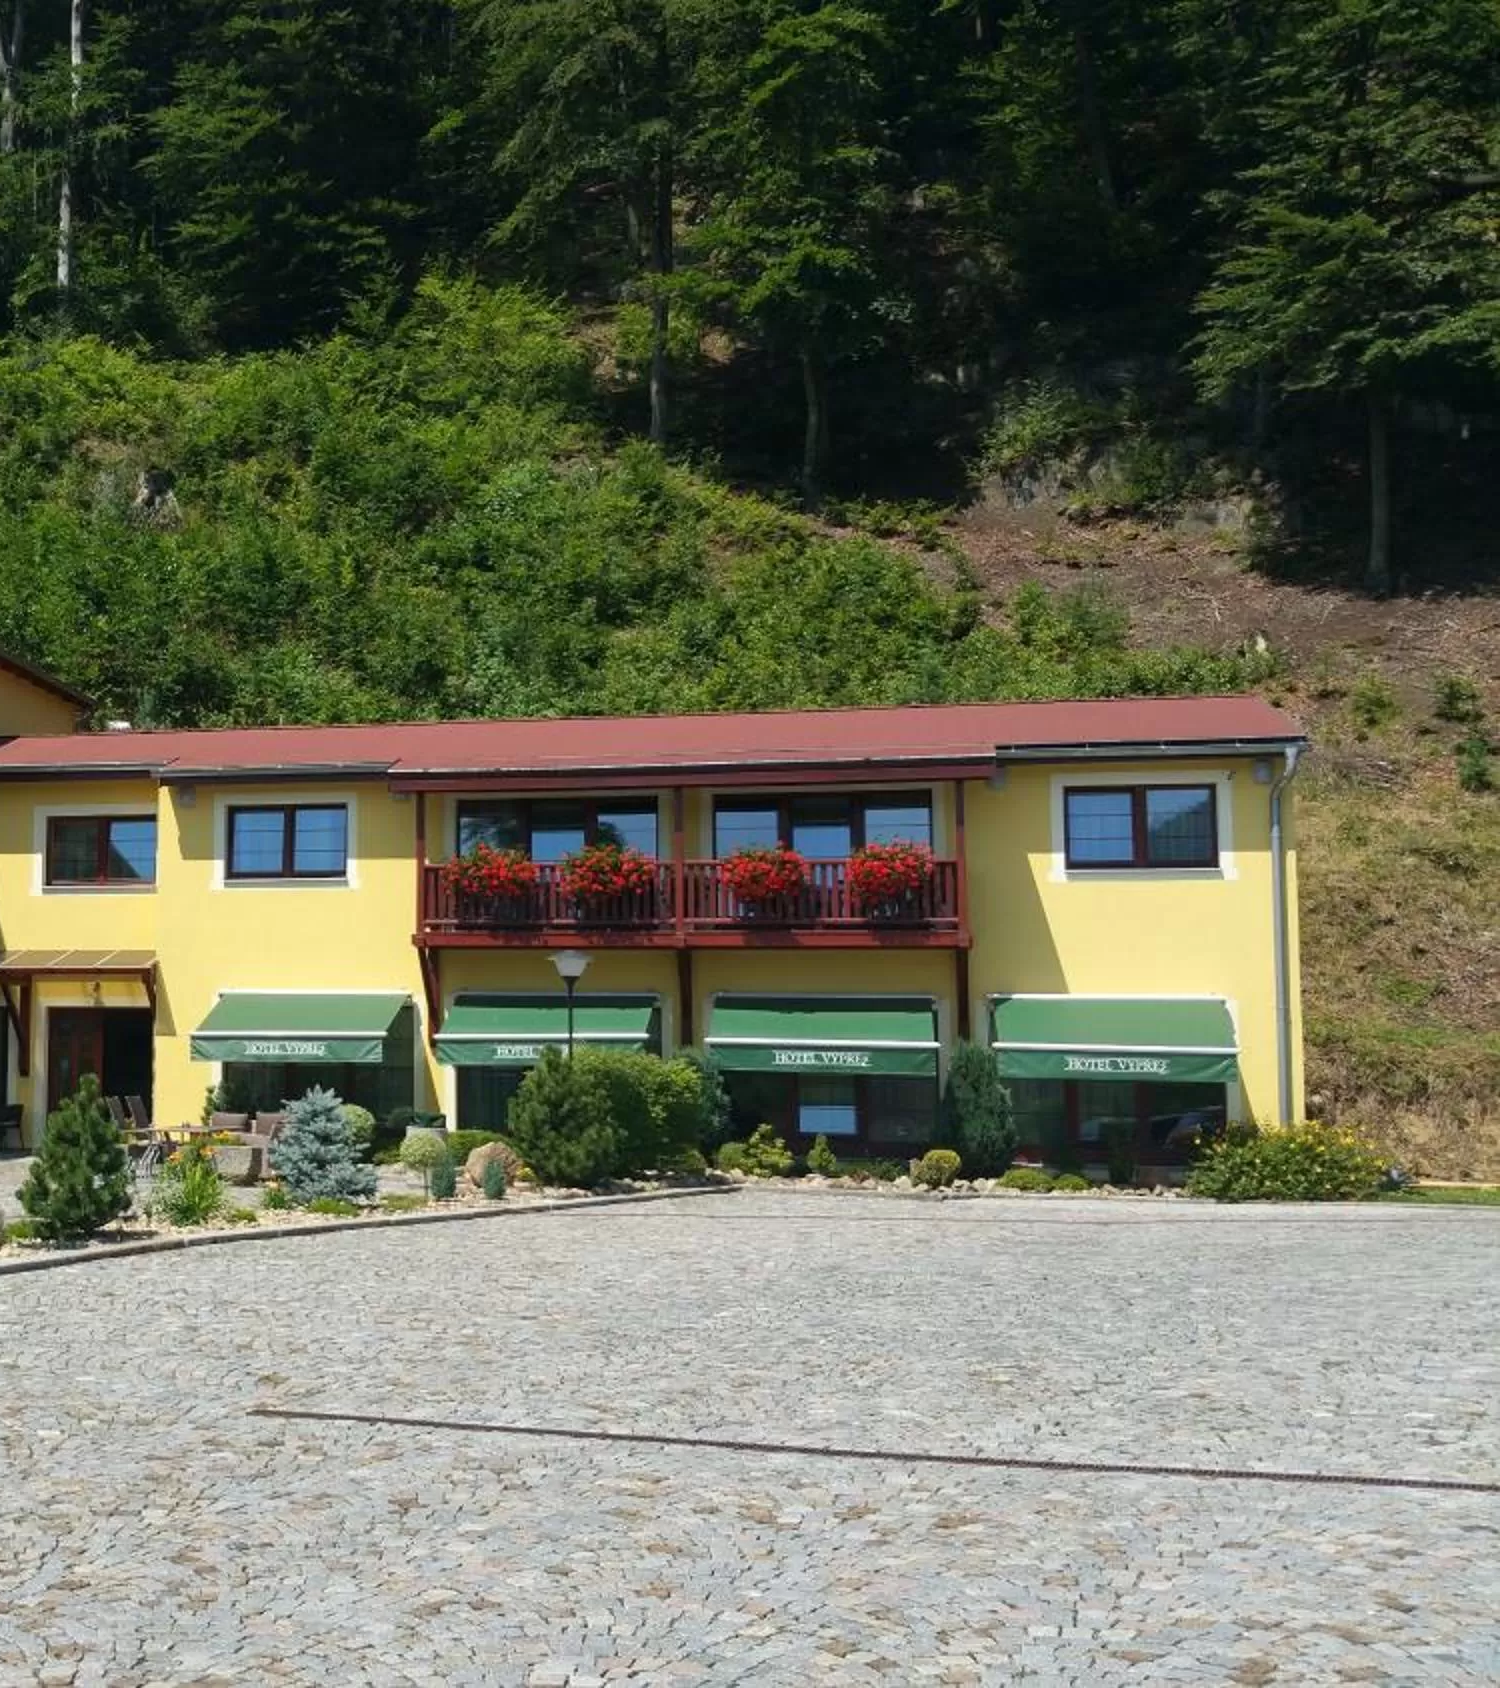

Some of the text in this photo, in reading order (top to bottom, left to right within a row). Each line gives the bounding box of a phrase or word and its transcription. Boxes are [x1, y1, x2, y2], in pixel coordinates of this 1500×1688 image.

[245, 1041, 281, 1055] HOTEL
[493, 1045, 540, 1059] HOTEL
[773, 1050, 818, 1065] HOTEL
[1065, 1056, 1113, 1071] HOTEL
